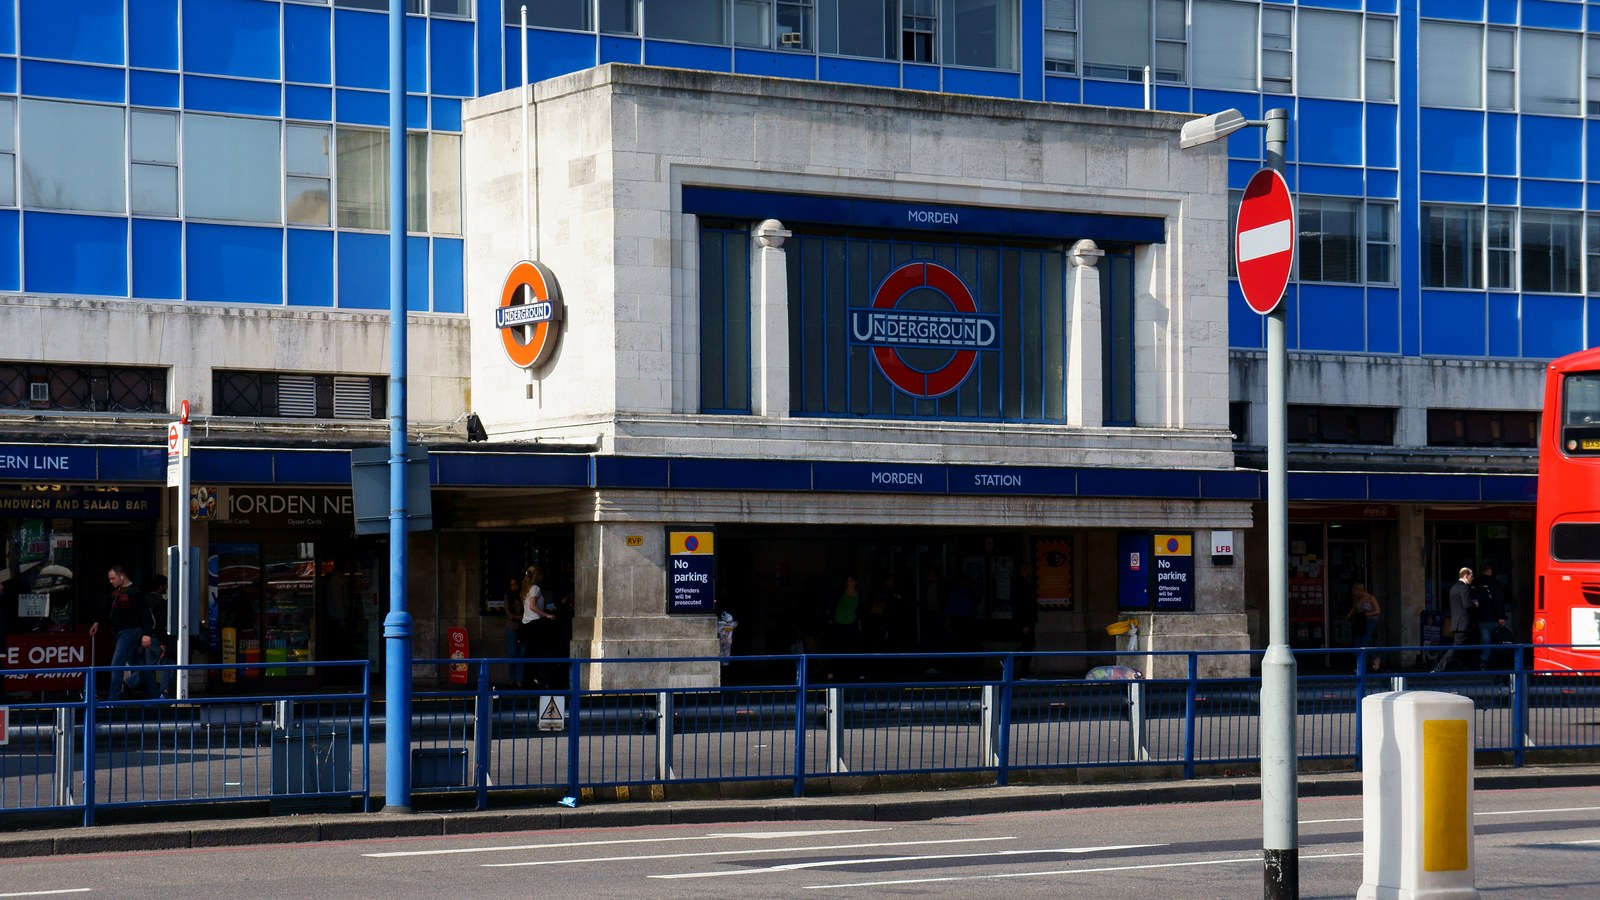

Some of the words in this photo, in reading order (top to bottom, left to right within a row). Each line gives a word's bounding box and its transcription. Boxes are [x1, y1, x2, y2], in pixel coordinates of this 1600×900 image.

[908, 210, 958, 224] MORDEN
[496, 302, 551, 327] UNDERGROUND
[853, 312, 995, 346] UNDERGROUND
[34, 456, 69, 470] LINE
[871, 472, 923, 485] MORDEN
[974, 474, 1022, 486] STATION
[55, 500, 79, 510] AND
[83, 500, 119, 510] SALAD
[125, 500, 148, 511] BAR
[674, 559, 689, 569] No
[1158, 560, 1171, 569] No
[674, 571, 708, 584] parking
[1158, 571, 1187, 582] parking
[28, 646, 84, 664] OPEN
